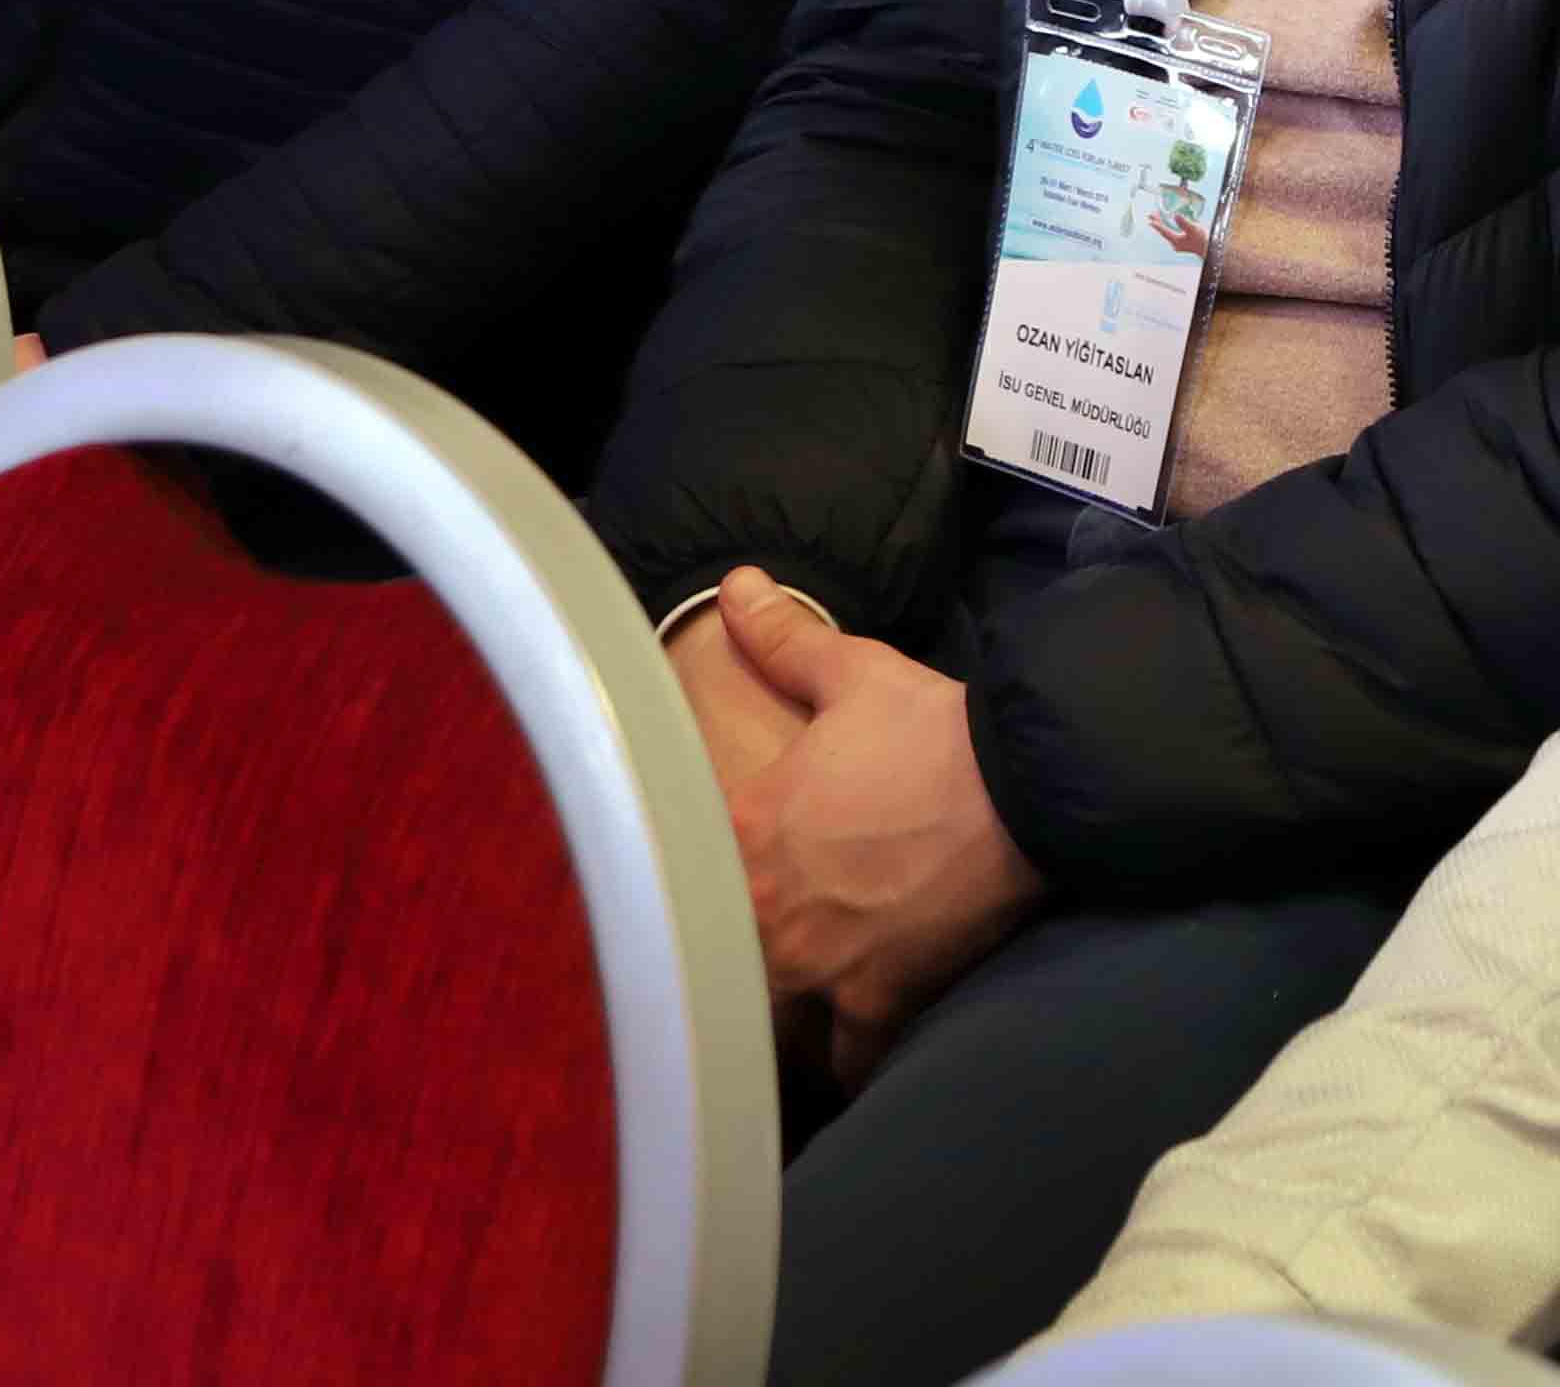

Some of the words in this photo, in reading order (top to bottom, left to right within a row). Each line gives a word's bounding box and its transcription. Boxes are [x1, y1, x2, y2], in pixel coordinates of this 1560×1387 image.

[1016, 323, 1061, 353] OZAN
[1066, 337, 1154, 385] YİĞİTASLAN
[998, 370, 1022, 394] İSU
[1024, 381, 1067, 411] GENEL
[1070, 396, 1152, 439] MÜDÜRLÜĞÜ
